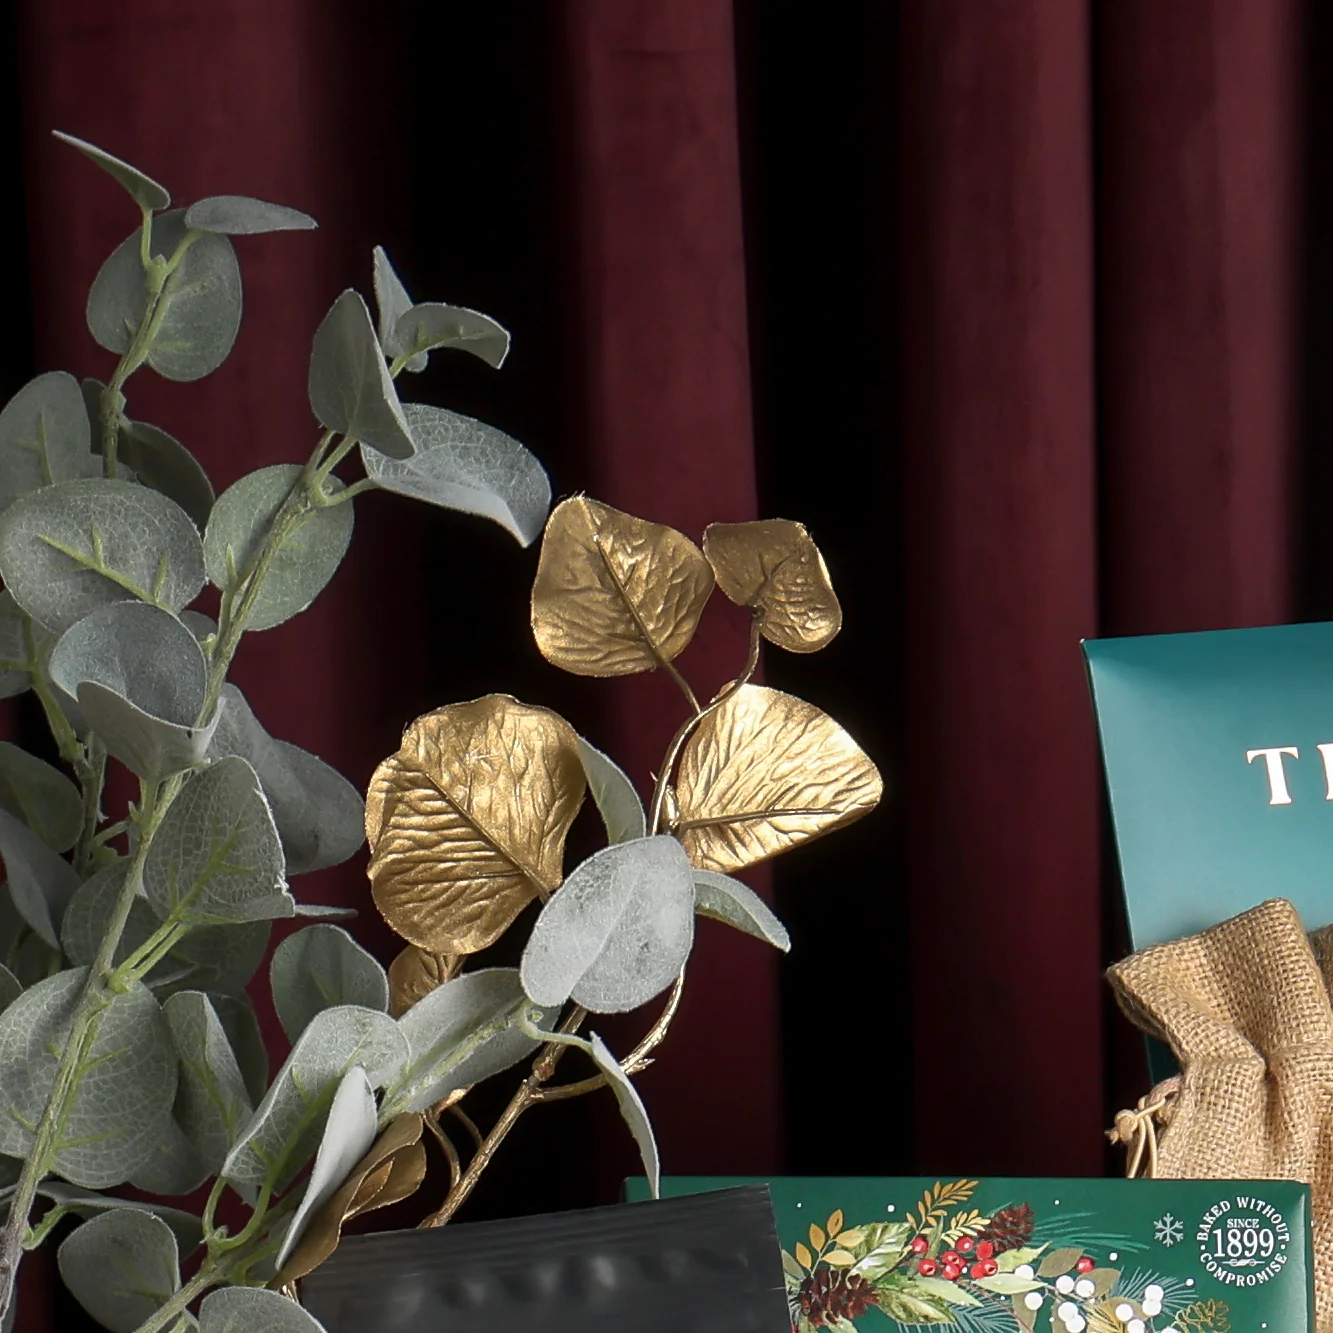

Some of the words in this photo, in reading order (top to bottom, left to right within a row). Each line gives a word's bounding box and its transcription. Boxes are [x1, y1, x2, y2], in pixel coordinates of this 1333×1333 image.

[1197, 1200, 1230, 1241] BAKED
[1237, 1197, 1290, 1242] WITHOUT
[1227, 1218, 1259, 1228] SINCE
[1213, 1229, 1274, 1257] 1899
[1200, 1253, 1287, 1287] COMPROMISE
